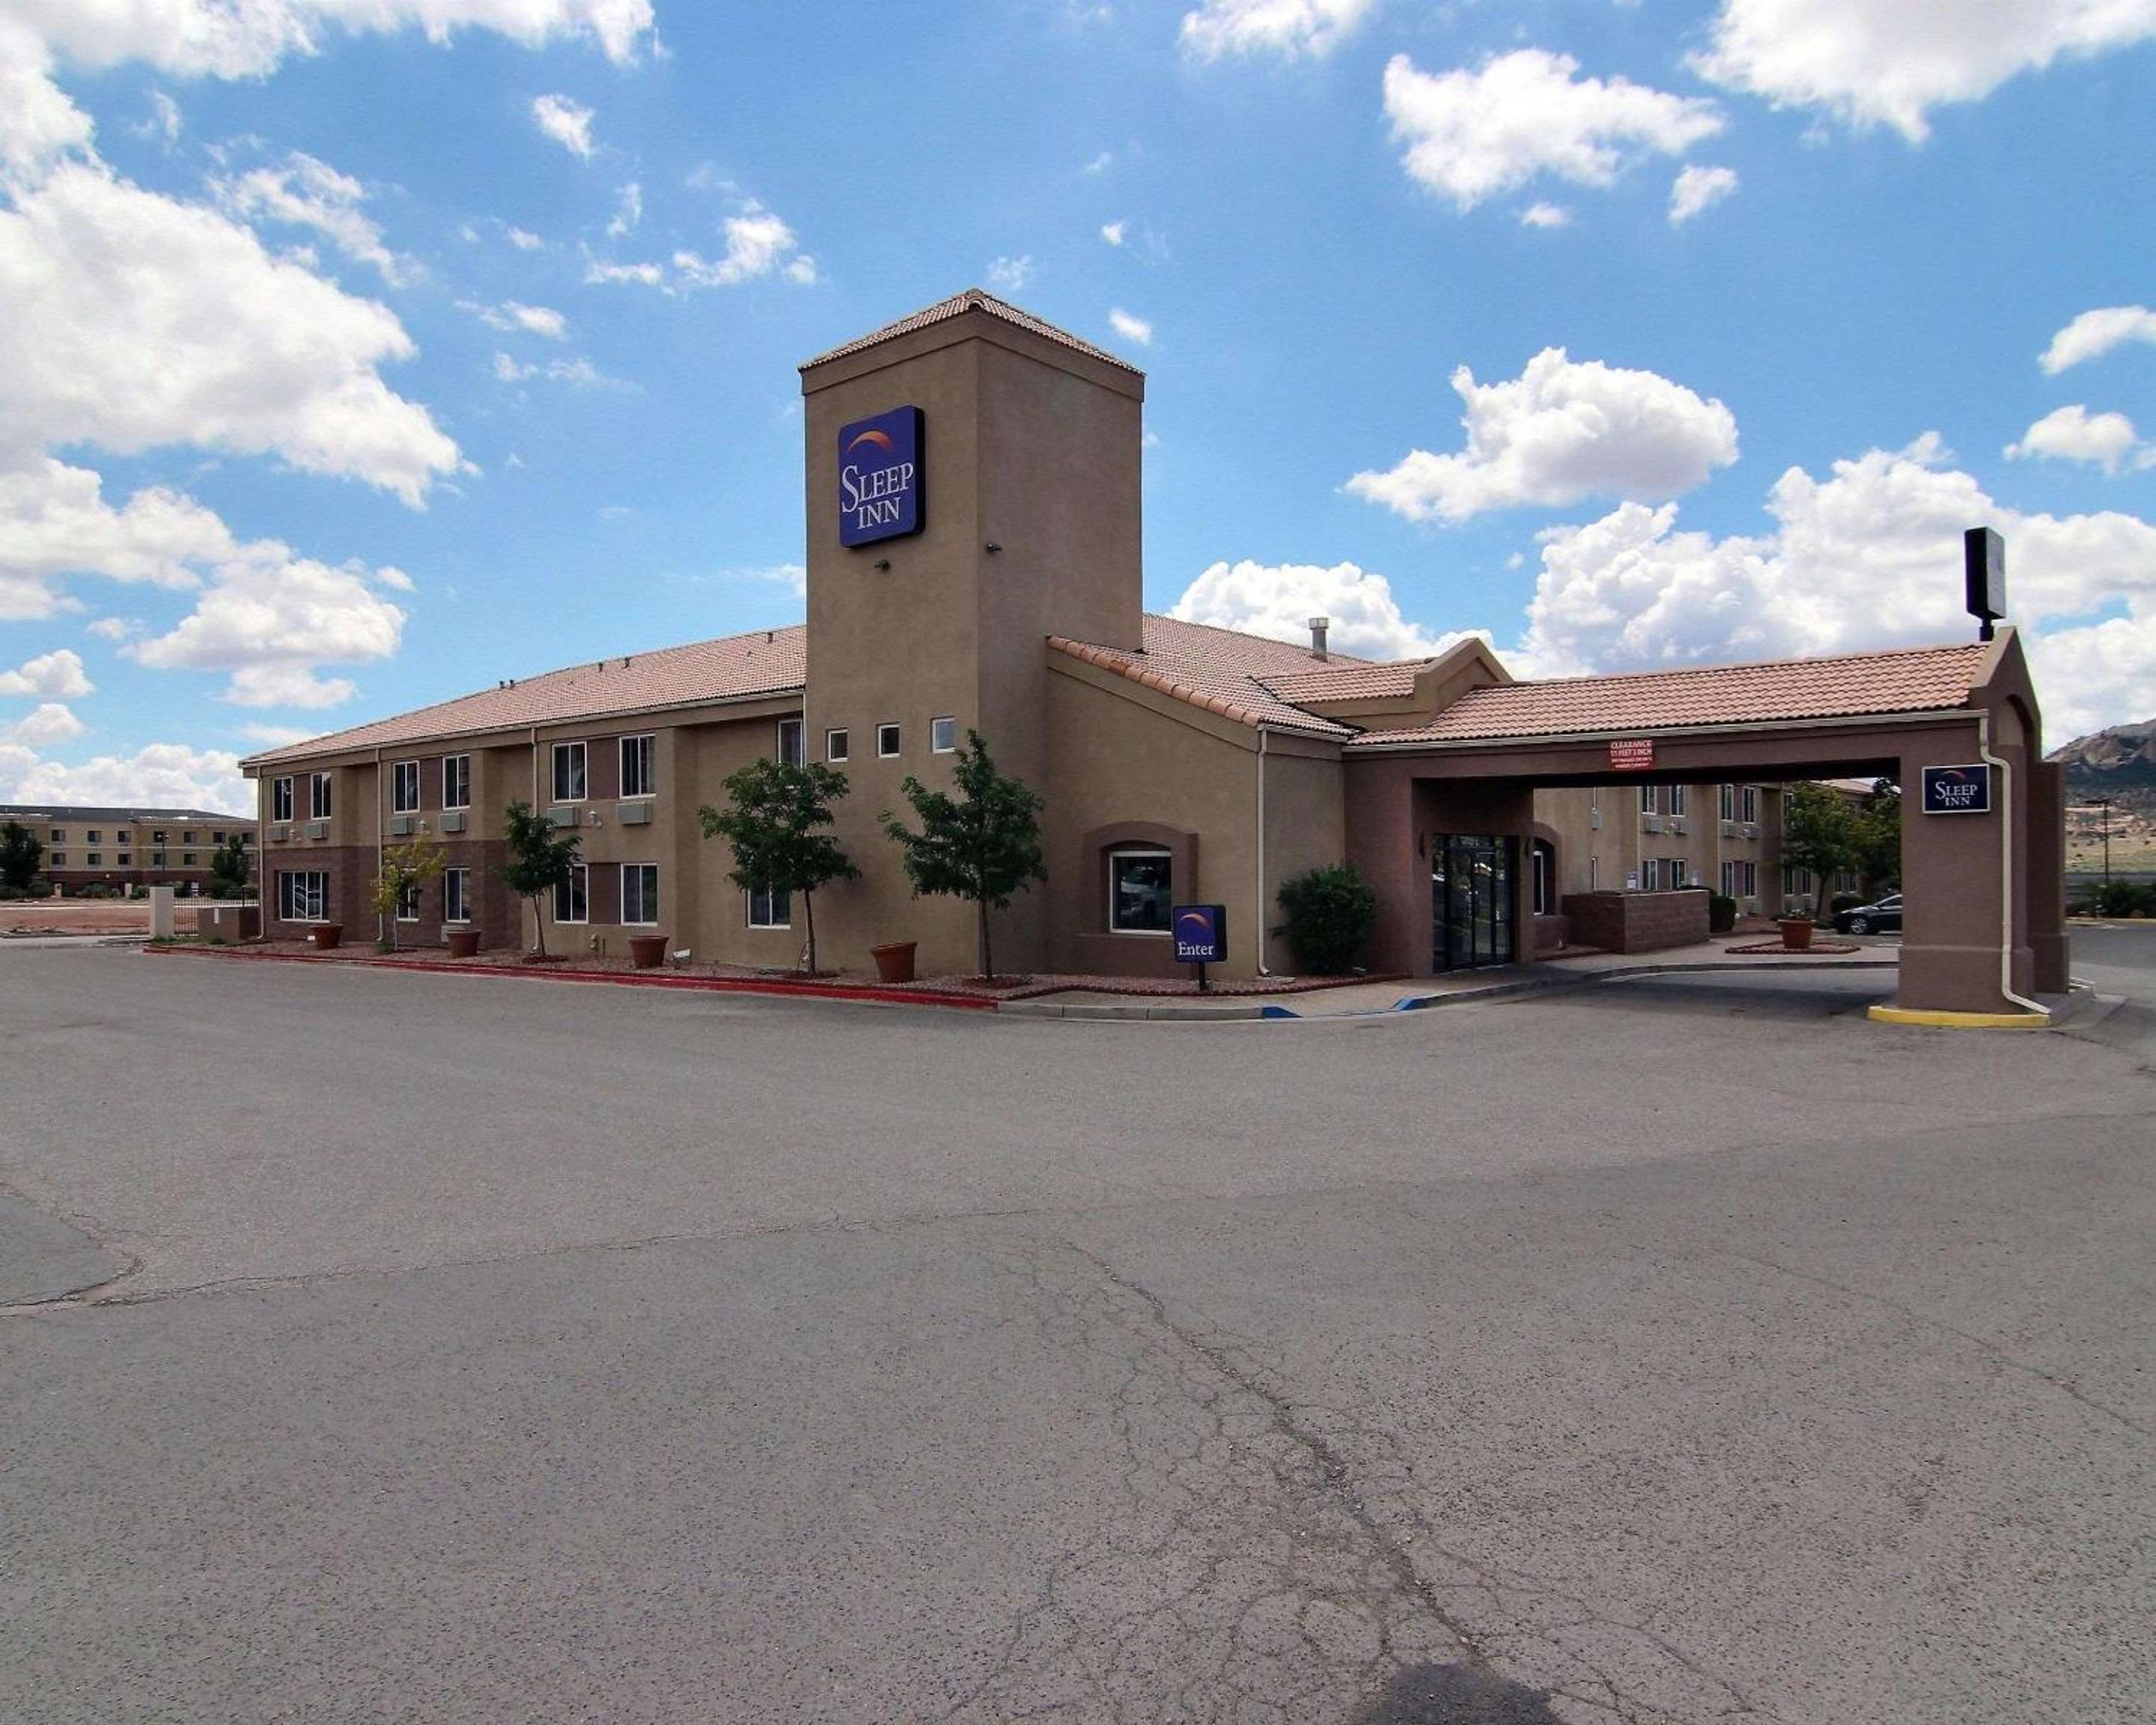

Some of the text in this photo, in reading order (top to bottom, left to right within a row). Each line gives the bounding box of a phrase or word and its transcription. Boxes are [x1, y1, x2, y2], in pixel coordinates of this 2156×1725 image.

[842, 462, 913, 513] SLEEP
[857, 496, 901, 529] INN
[1610, 740, 1652, 749] CLEARANCE
[1935, 782, 1978, 800] SLEEP
[1946, 796, 1970, 806] INN
[1178, 941, 1214, 955] Enter
